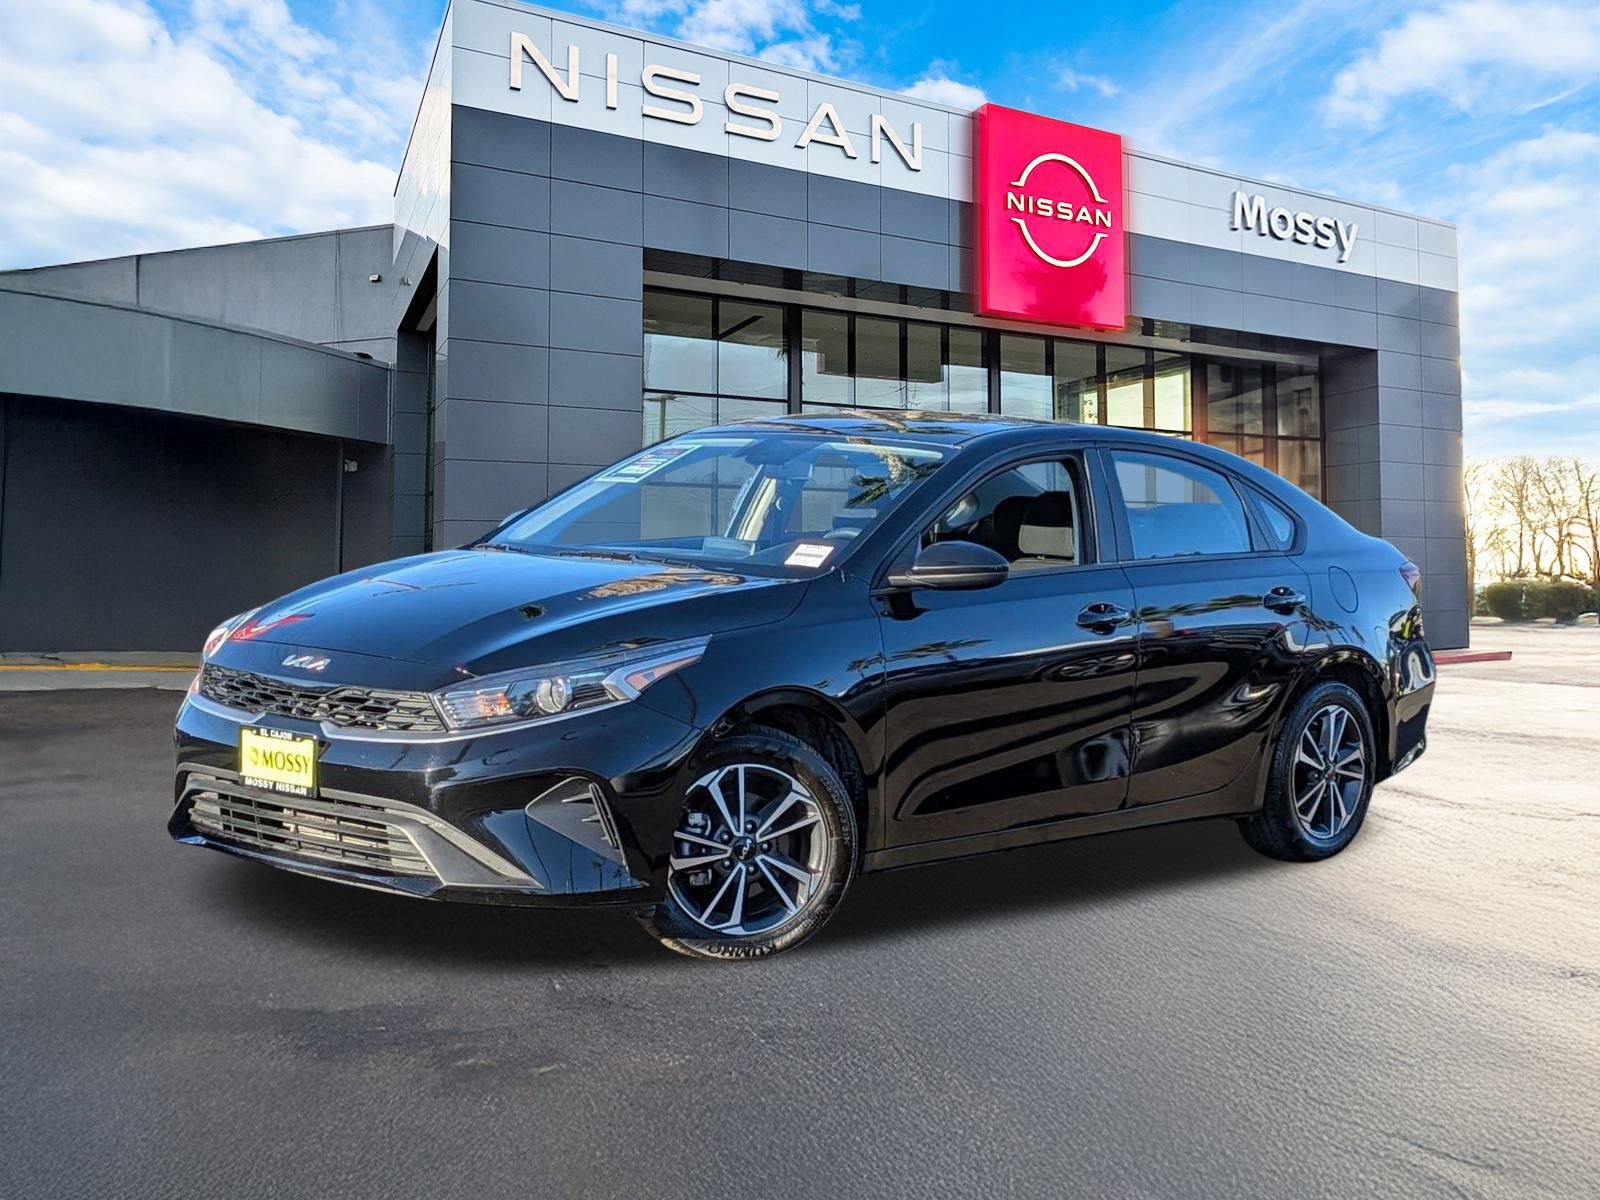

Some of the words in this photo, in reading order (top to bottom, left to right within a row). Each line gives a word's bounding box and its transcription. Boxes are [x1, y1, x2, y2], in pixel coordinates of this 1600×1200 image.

[509, 31, 922, 171] NISSAN
[1007, 191, 1112, 228] NISSAN
[1231, 189, 1359, 263] Mossy
[260, 728, 268, 737] EL
[270, 729, 292, 740] CAJON
[262, 751, 311, 774] MOSSY
[244, 777, 275, 790] MOSSY
[275, 781, 307, 796] NISSAN
[708, 943, 777, 957] KUMHO
